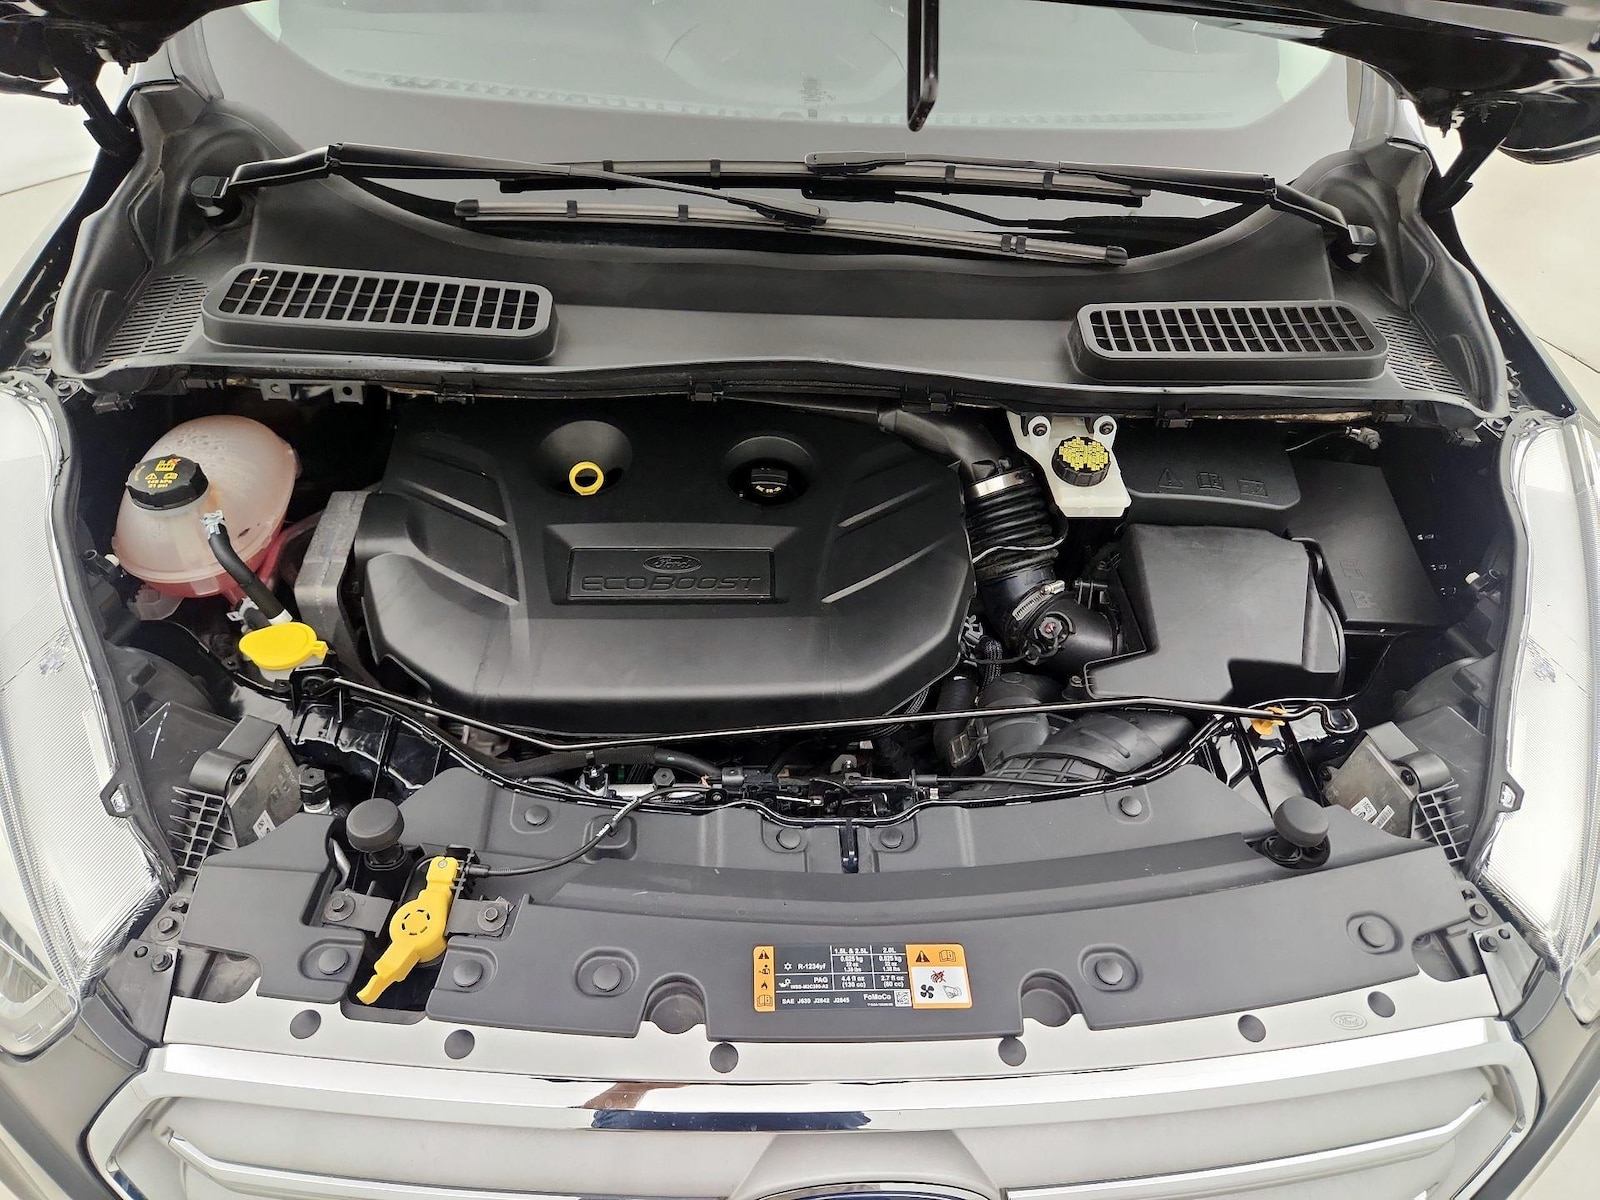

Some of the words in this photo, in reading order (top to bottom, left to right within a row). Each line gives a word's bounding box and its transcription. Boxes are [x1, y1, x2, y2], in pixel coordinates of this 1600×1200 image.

[654, 555, 692, 569] Ford
[797, 962, 826, 971] R-1234yf
[813, 976, 828, 984] PAG
[856, 981, 866, 989] cc)
[862, 993, 892, 1001] FoMoCo
